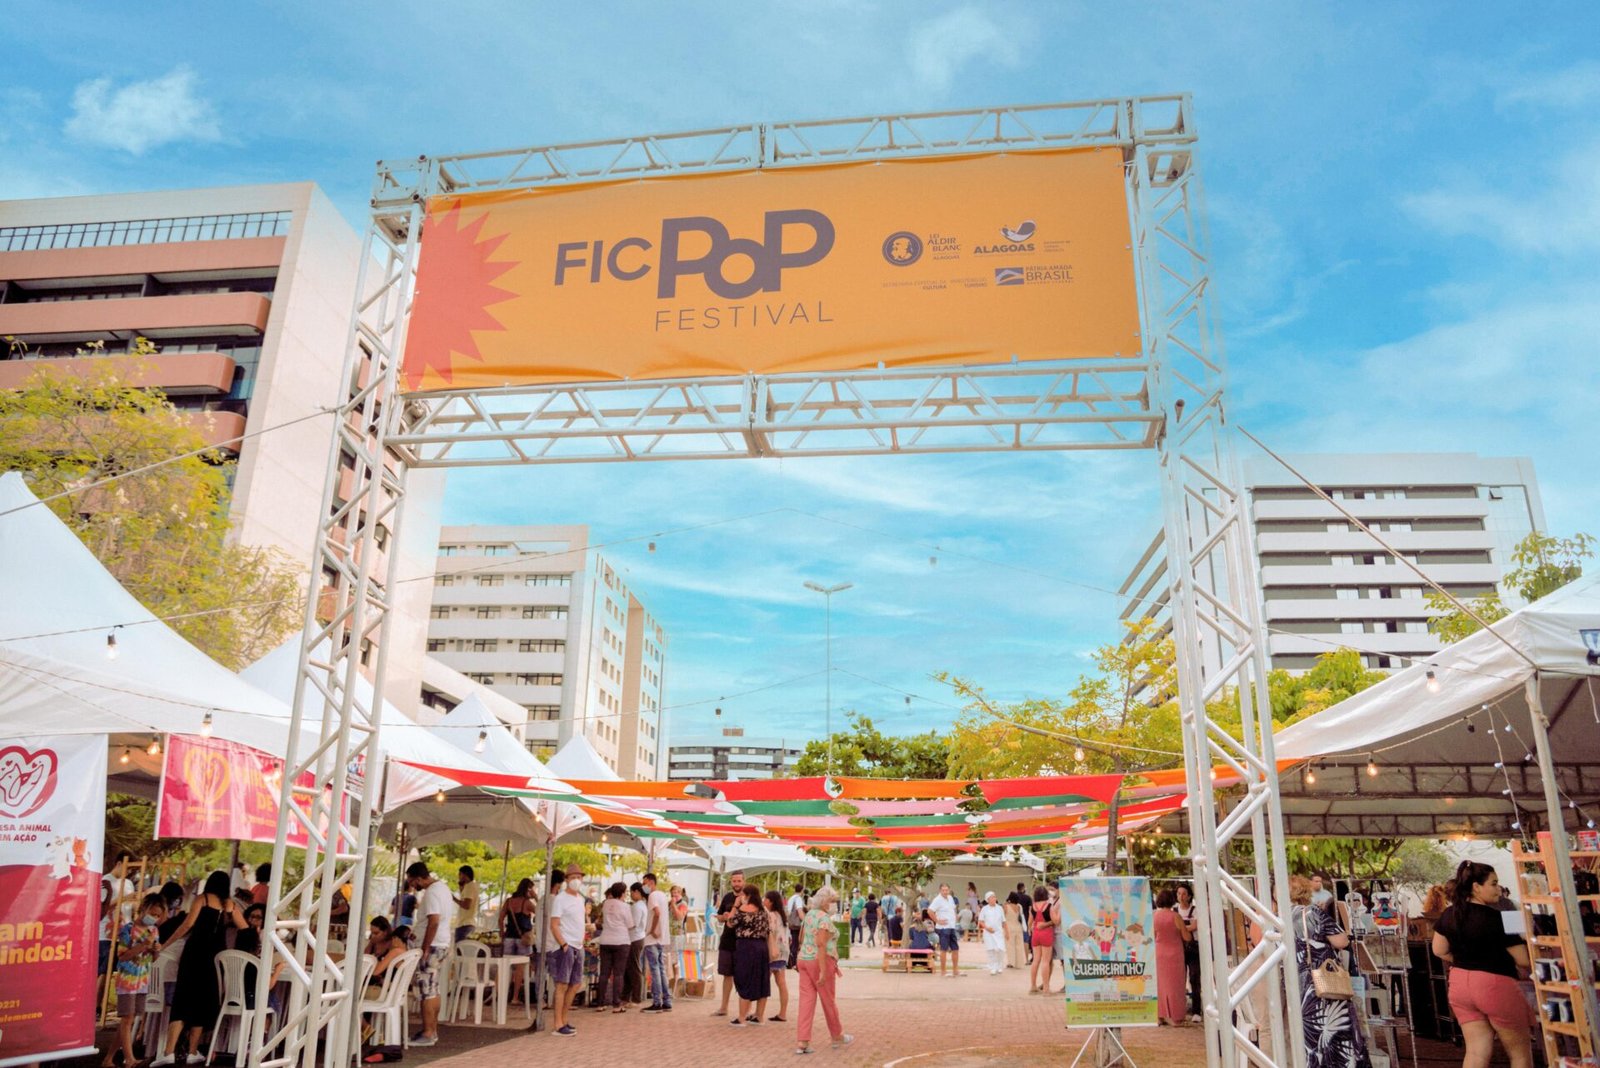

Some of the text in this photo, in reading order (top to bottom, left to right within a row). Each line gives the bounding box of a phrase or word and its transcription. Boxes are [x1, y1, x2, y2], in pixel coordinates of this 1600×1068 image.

[927, 237, 957, 246] ALDIR
[973, 243, 1036, 254] ALAGOAS
[1026, 270, 1074, 281] BRASIL
[655, 301, 834, 332] FESTIVAL
[19, 824, 52, 832] ANIMAL
[0, 920, 44, 942] am
[0, 940, 73, 966] indos!
